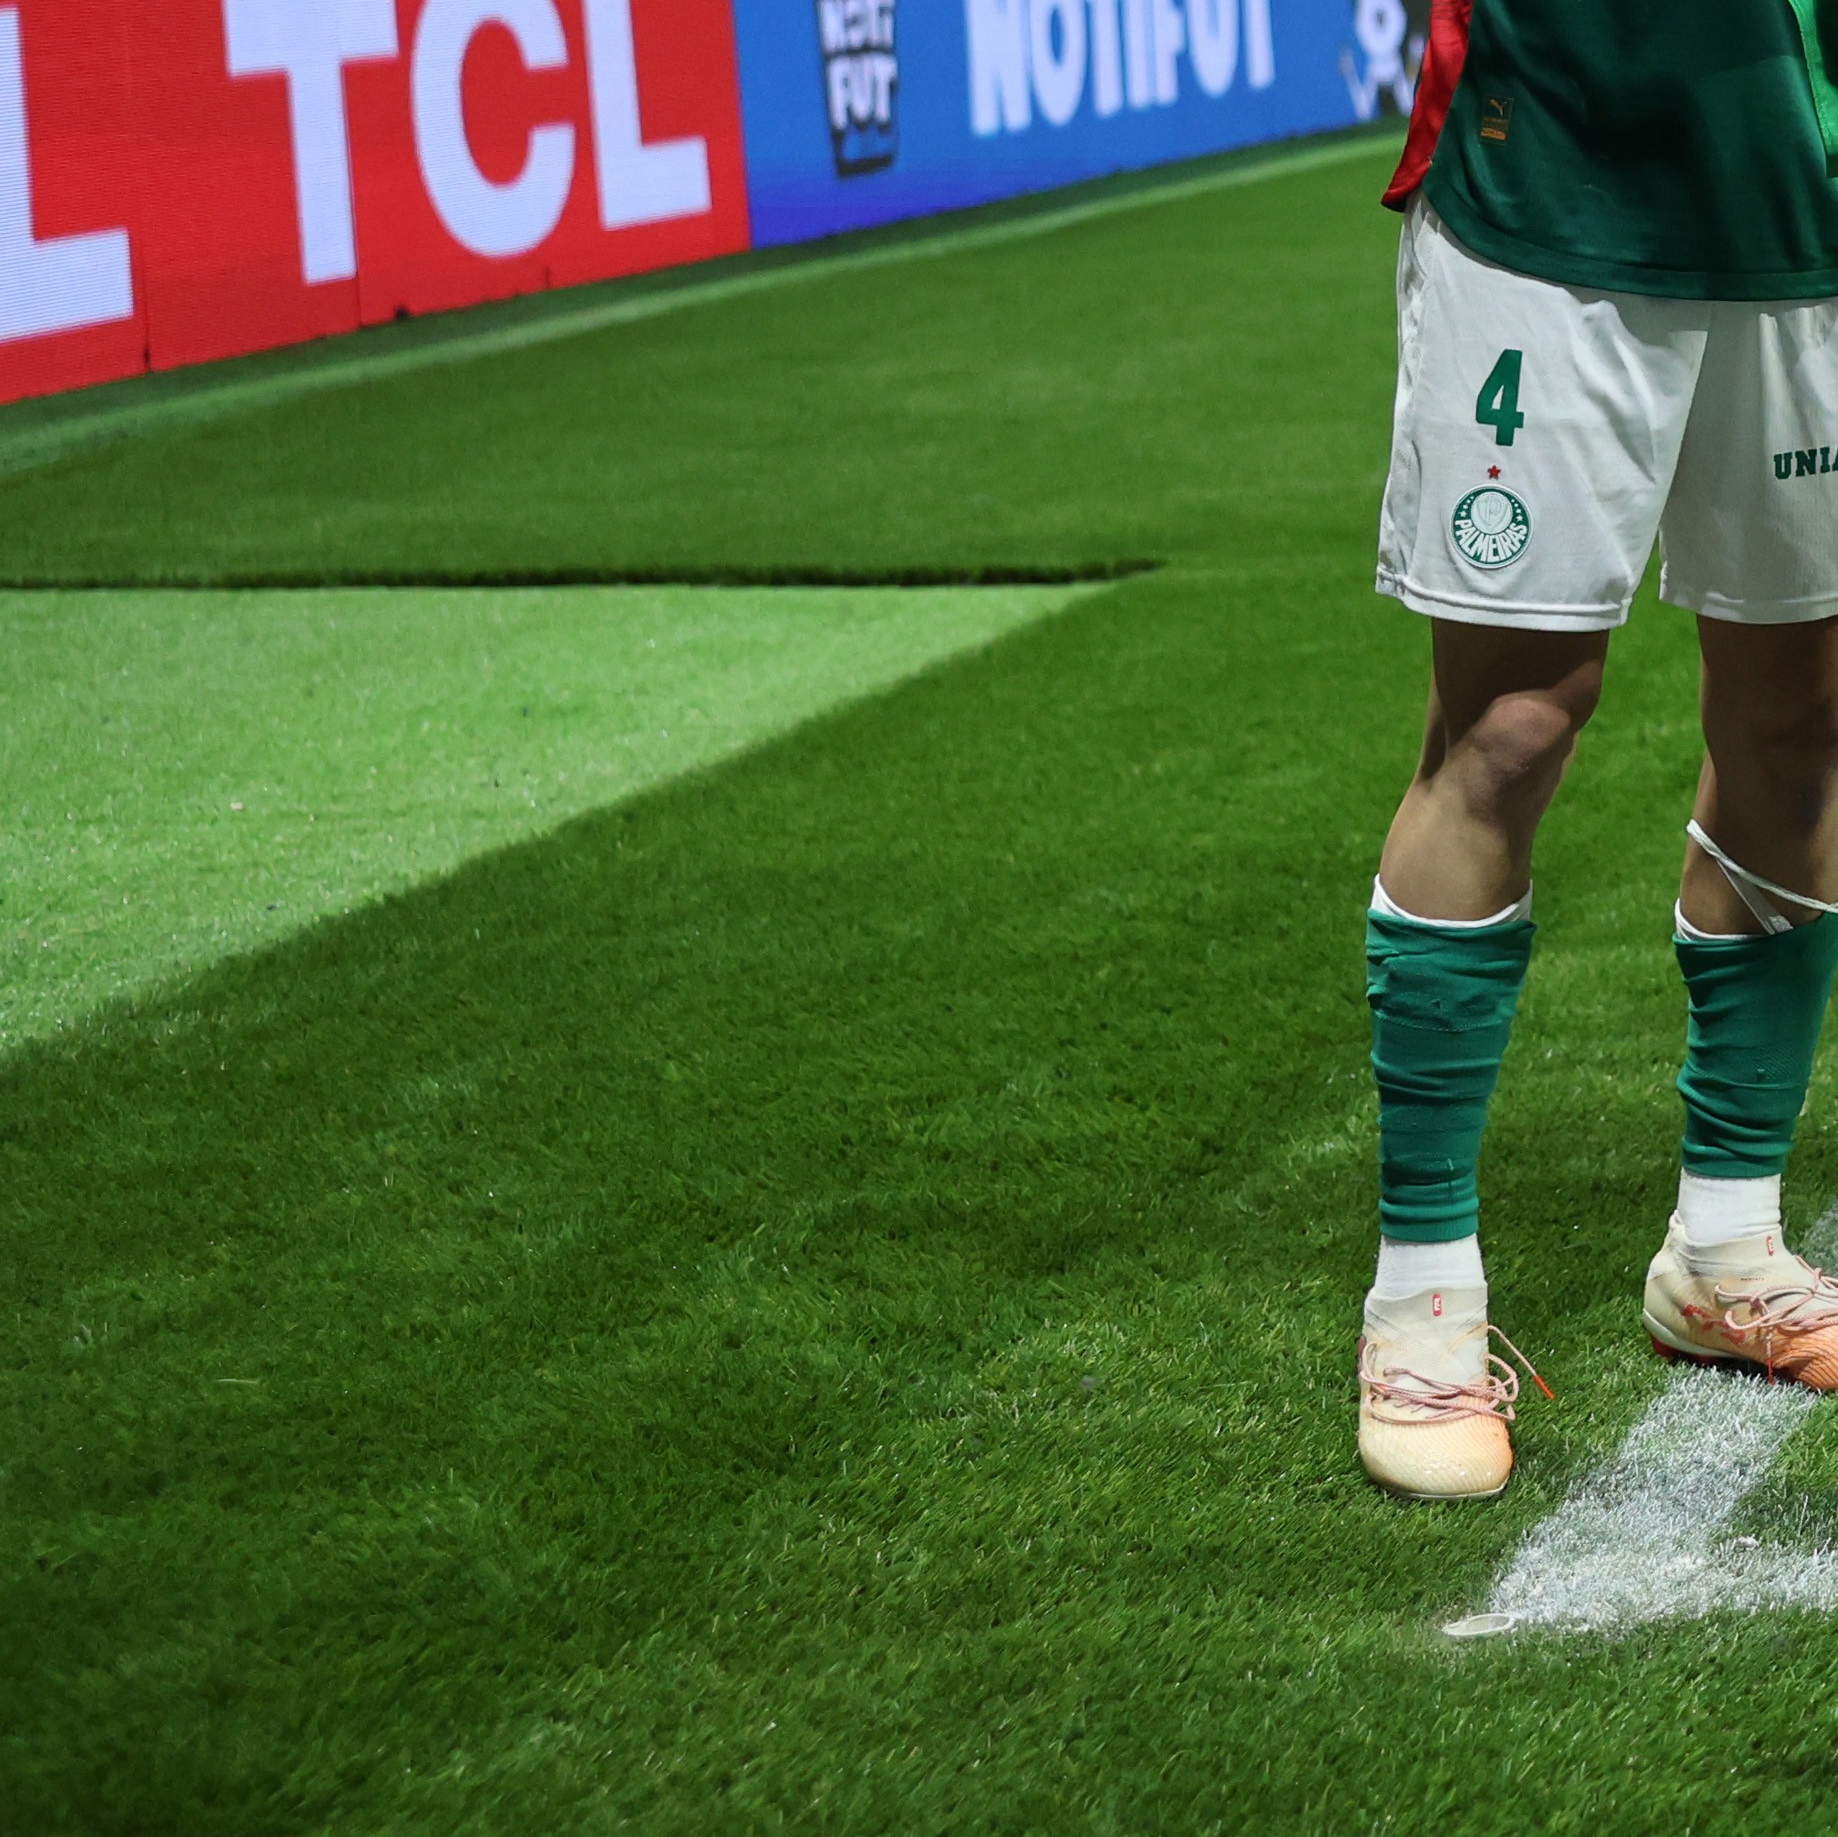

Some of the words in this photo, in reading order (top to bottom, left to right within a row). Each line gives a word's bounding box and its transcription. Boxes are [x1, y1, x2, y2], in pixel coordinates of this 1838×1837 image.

[826, 54, 899, 131] FUT
[1475, 348, 1525, 447] 4
[1455, 518, 1528, 564] PALMEIRAS
